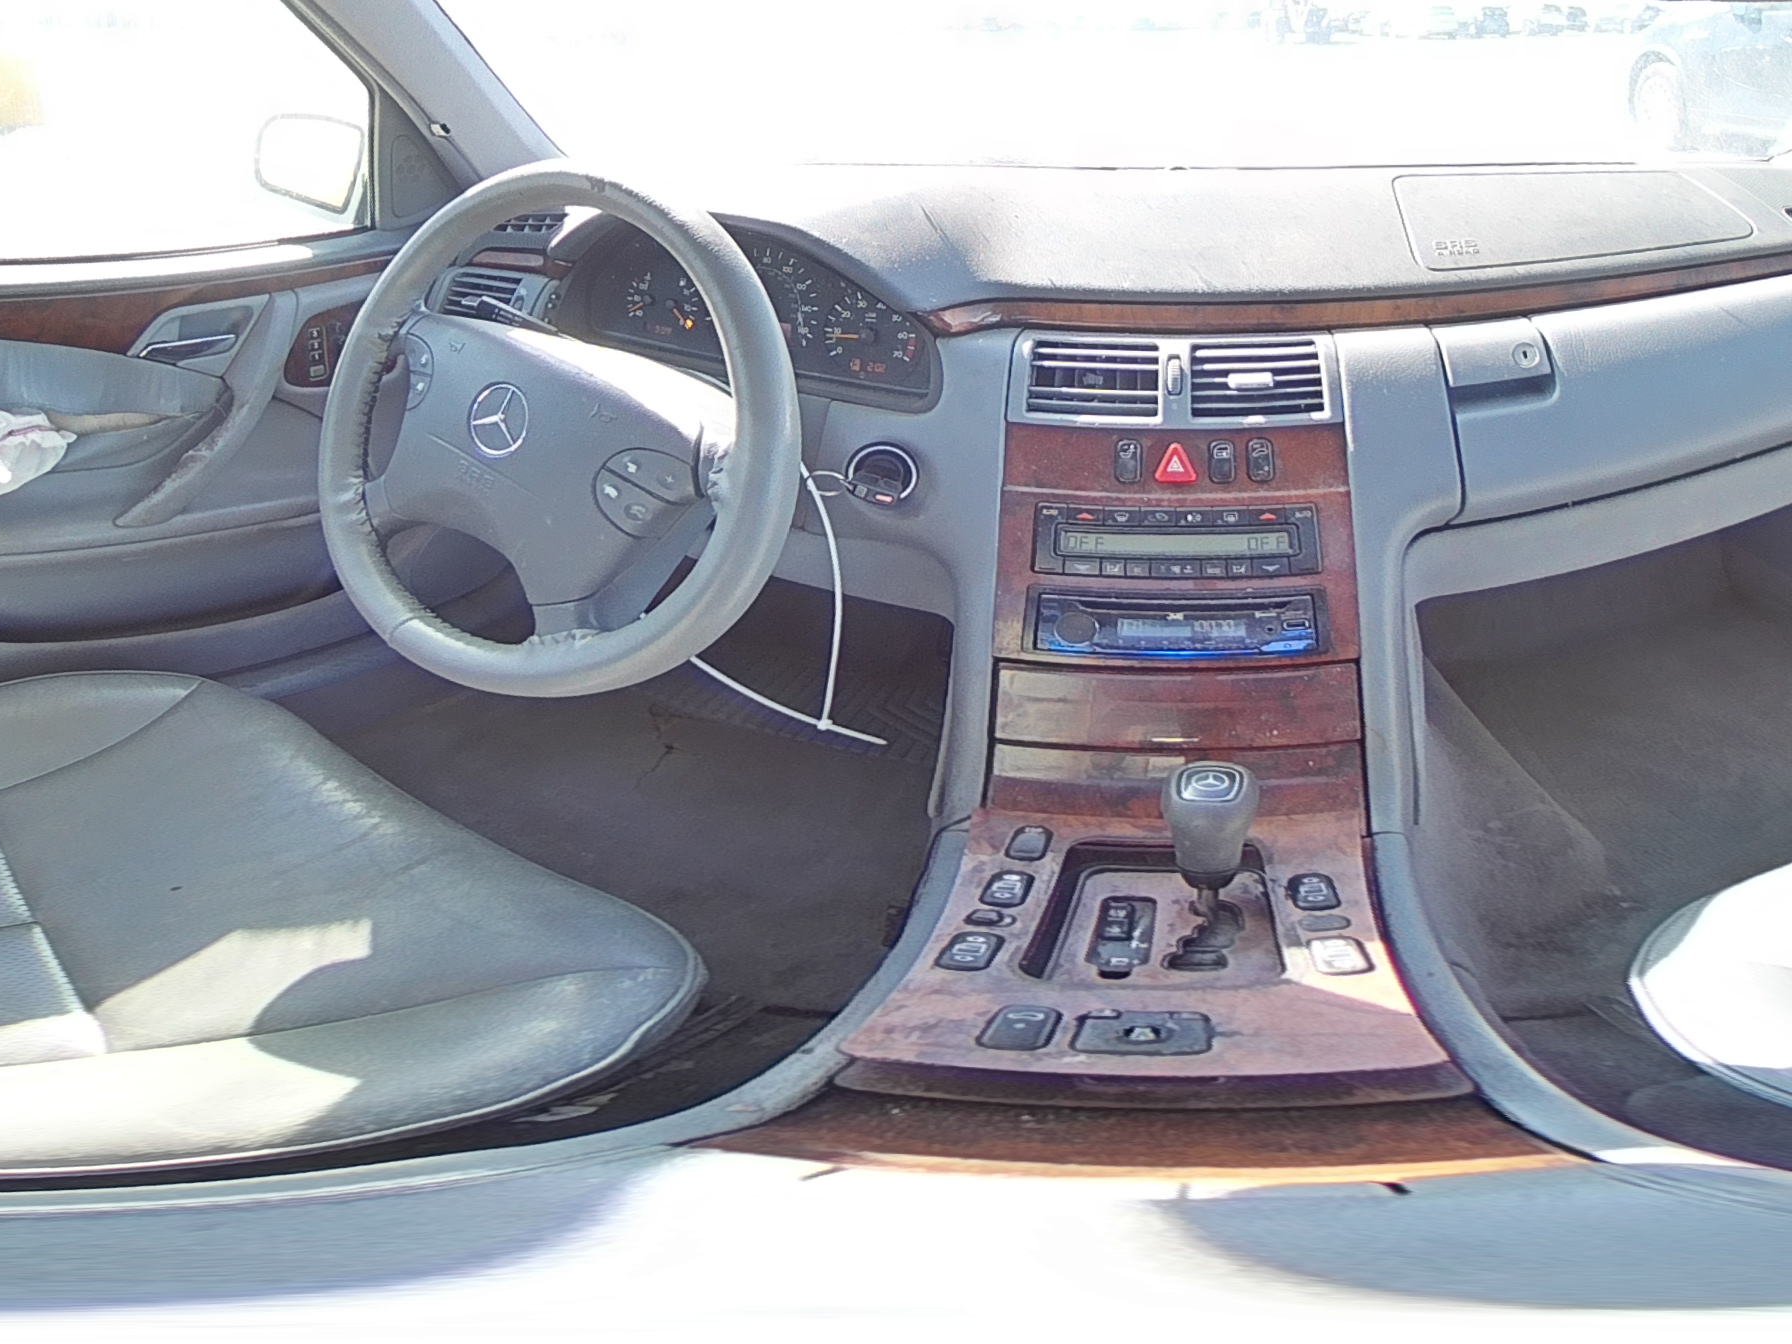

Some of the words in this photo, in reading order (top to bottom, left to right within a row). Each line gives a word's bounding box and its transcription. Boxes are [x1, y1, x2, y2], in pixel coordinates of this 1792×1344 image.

[1435, 239, 1478, 250] SRS
[856, 300, 867, 308] 30
[897, 331, 908, 339] 60
[1066, 534, 1105, 551] OFF
[1247, 536, 1286, 551] OFF
